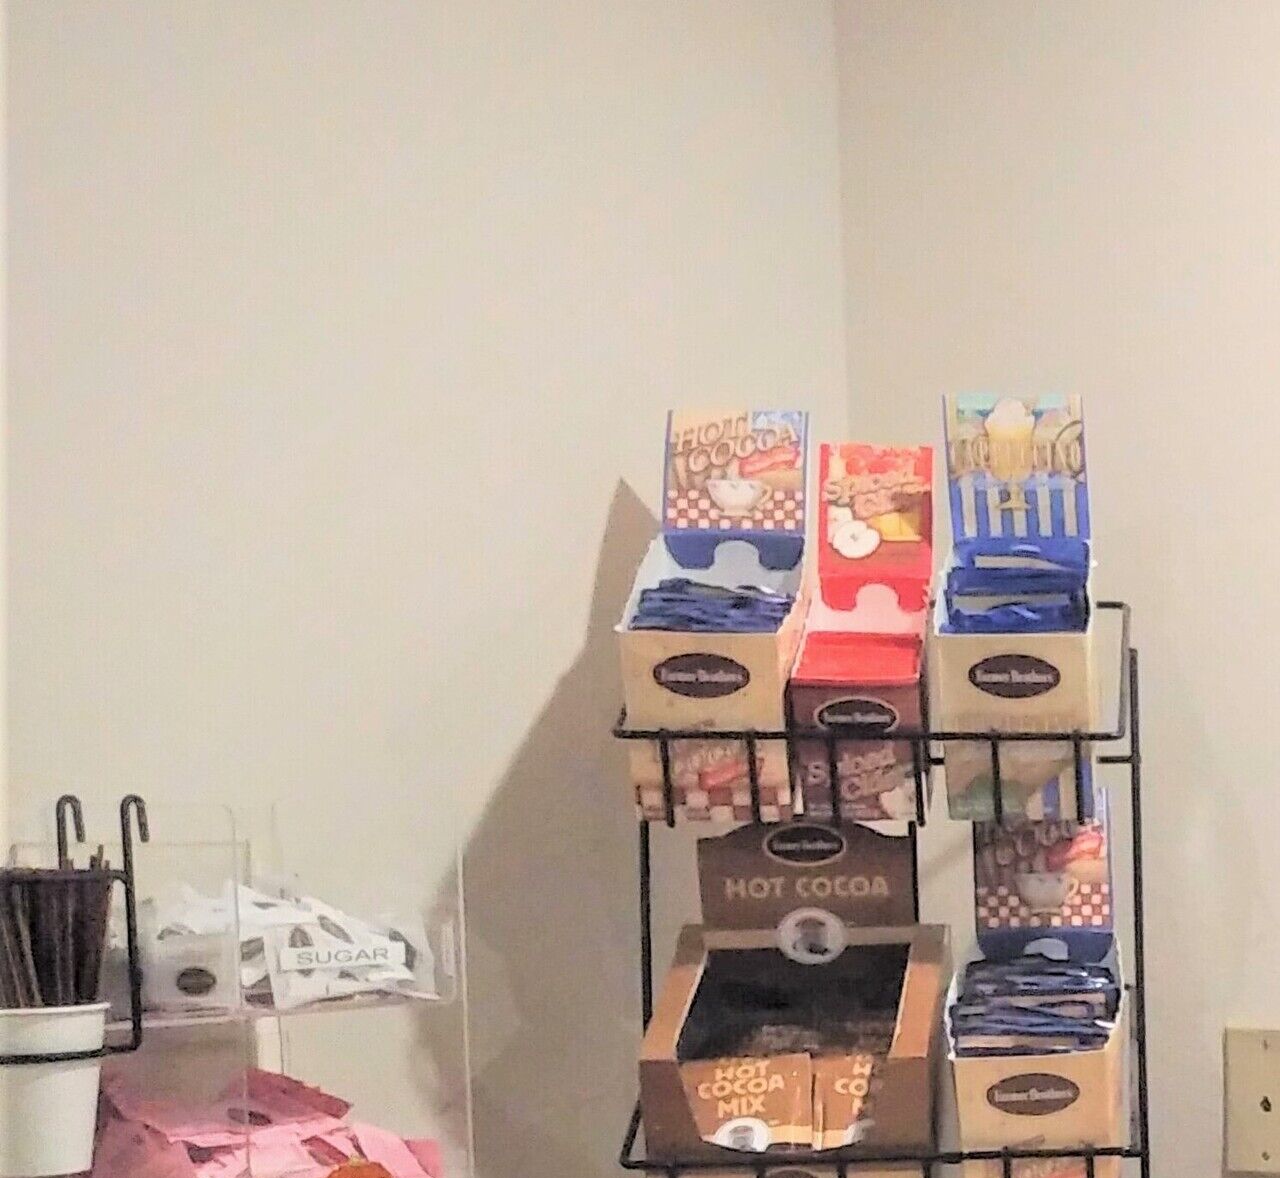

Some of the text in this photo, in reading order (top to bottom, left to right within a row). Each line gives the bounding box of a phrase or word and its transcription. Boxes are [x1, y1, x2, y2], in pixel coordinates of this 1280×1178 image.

[724, 876, 889, 899] HOT COCOA
[296, 947, 390, 965] SUGAR
[714, 1060, 771, 1081] HOT
[697, 1073, 786, 1100] COCOA
[717, 1094, 766, 1119] MIX
